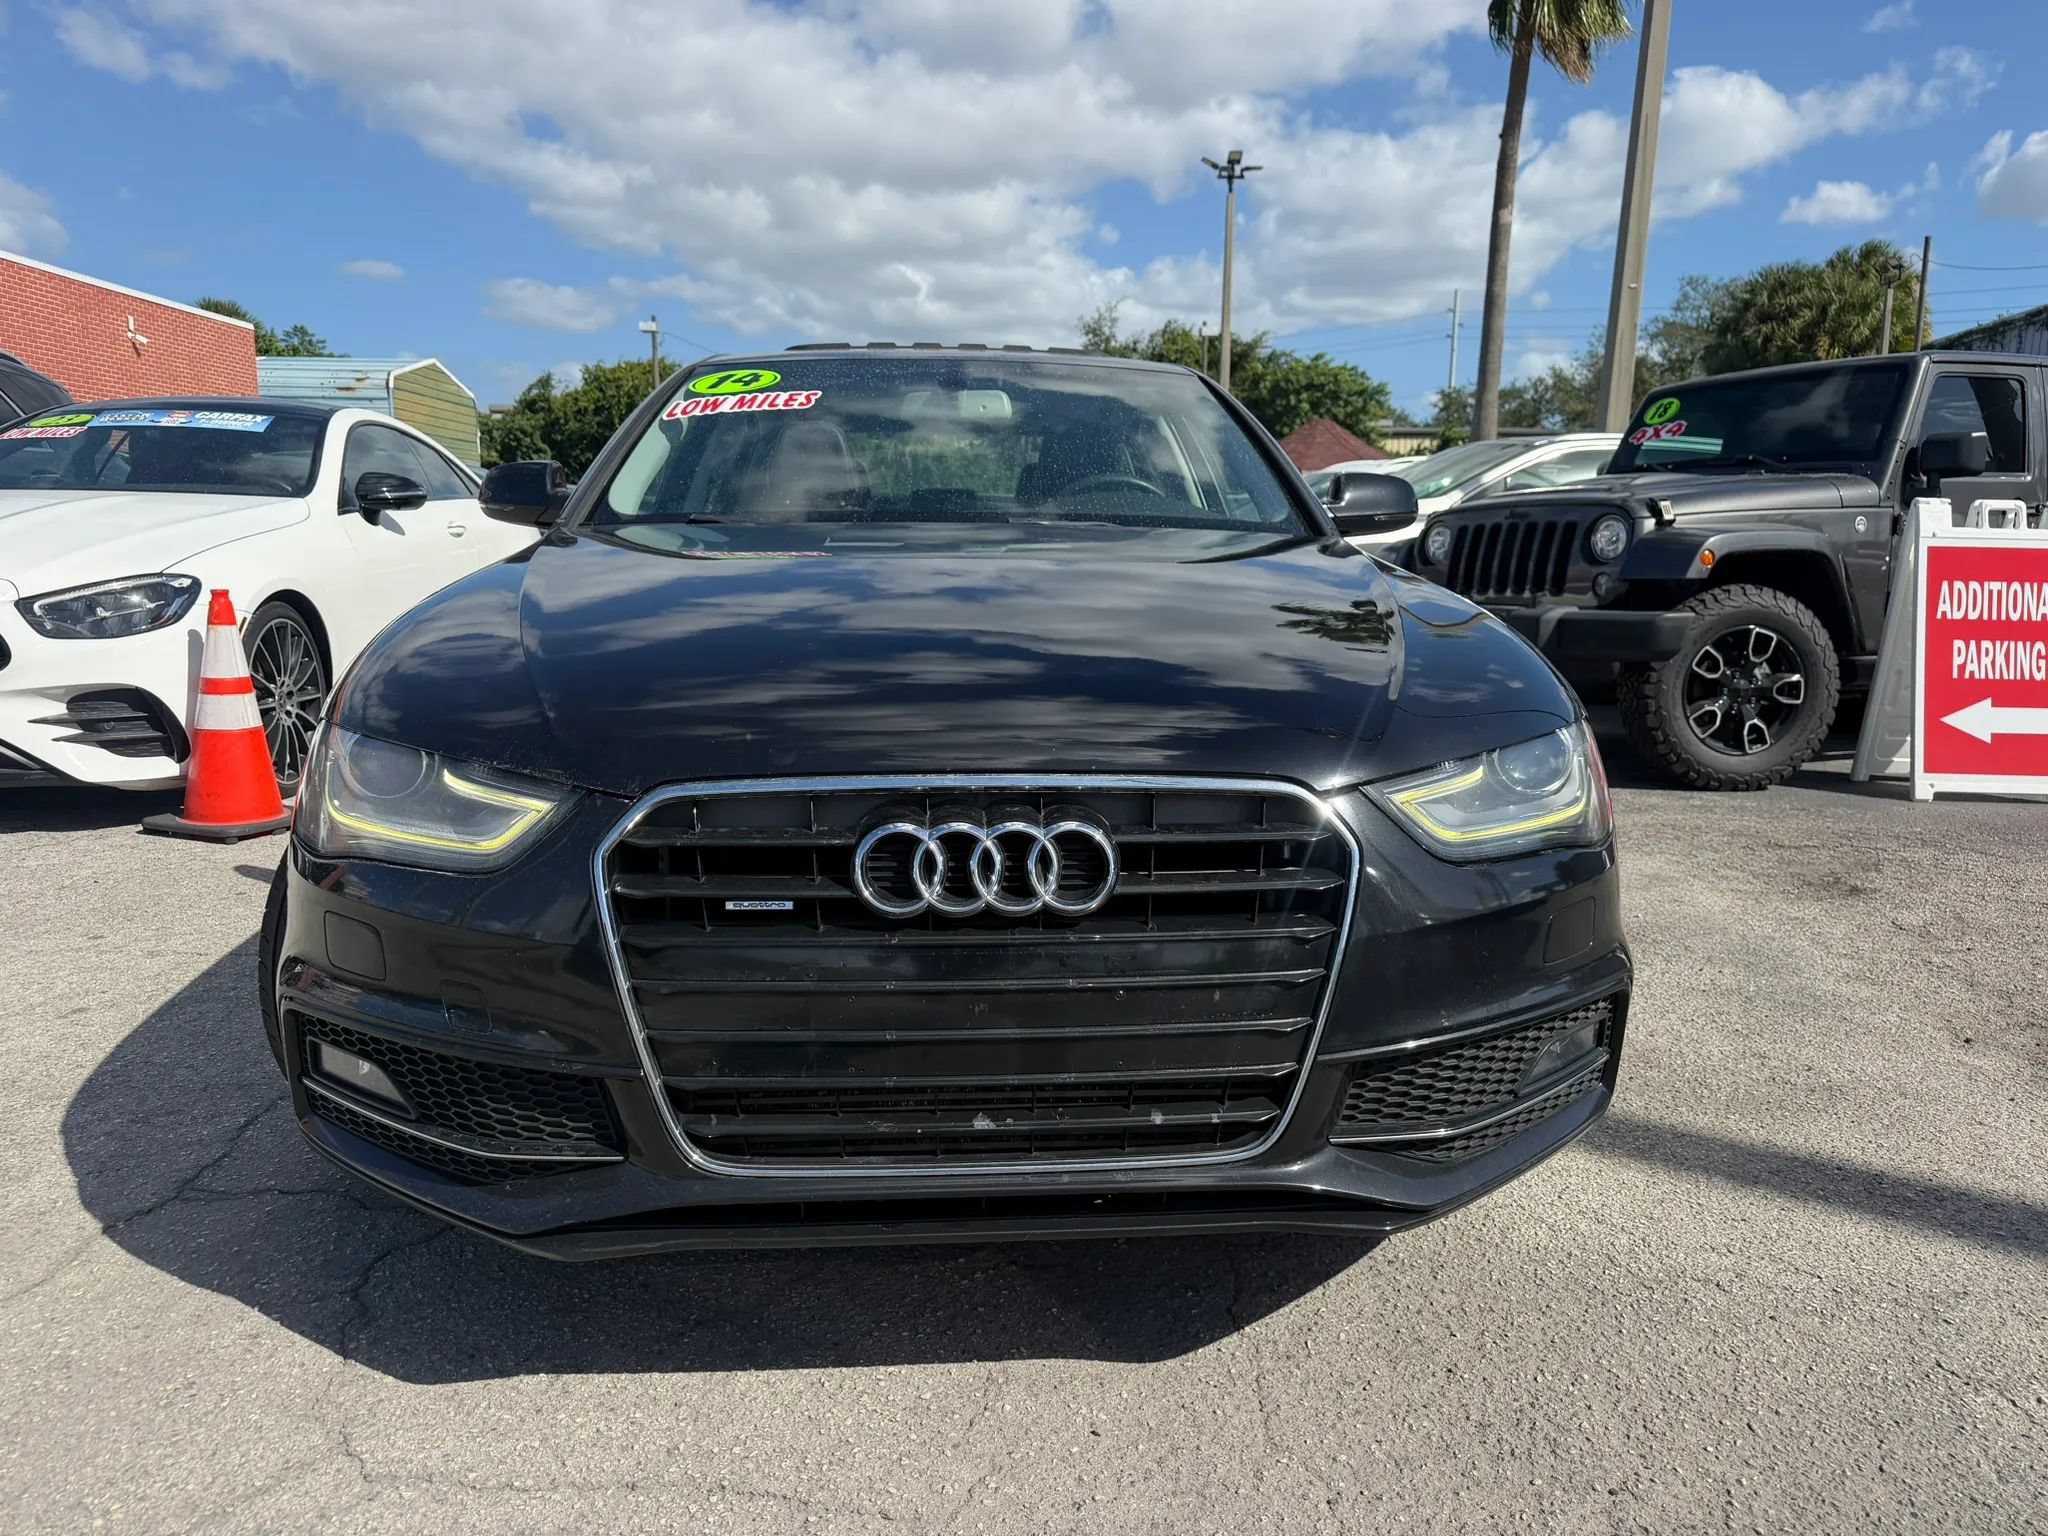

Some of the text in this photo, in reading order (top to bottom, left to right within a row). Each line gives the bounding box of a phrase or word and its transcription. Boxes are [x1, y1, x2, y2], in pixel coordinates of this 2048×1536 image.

[705, 372, 763, 390] 14
[665, 391, 819, 418] LOW MILES
[1648, 400, 1676, 421] 18
[194, 411, 268, 423] CARFAX
[1952, 639, 2046, 681] PARKING
[732, 901, 786, 909] quattro
